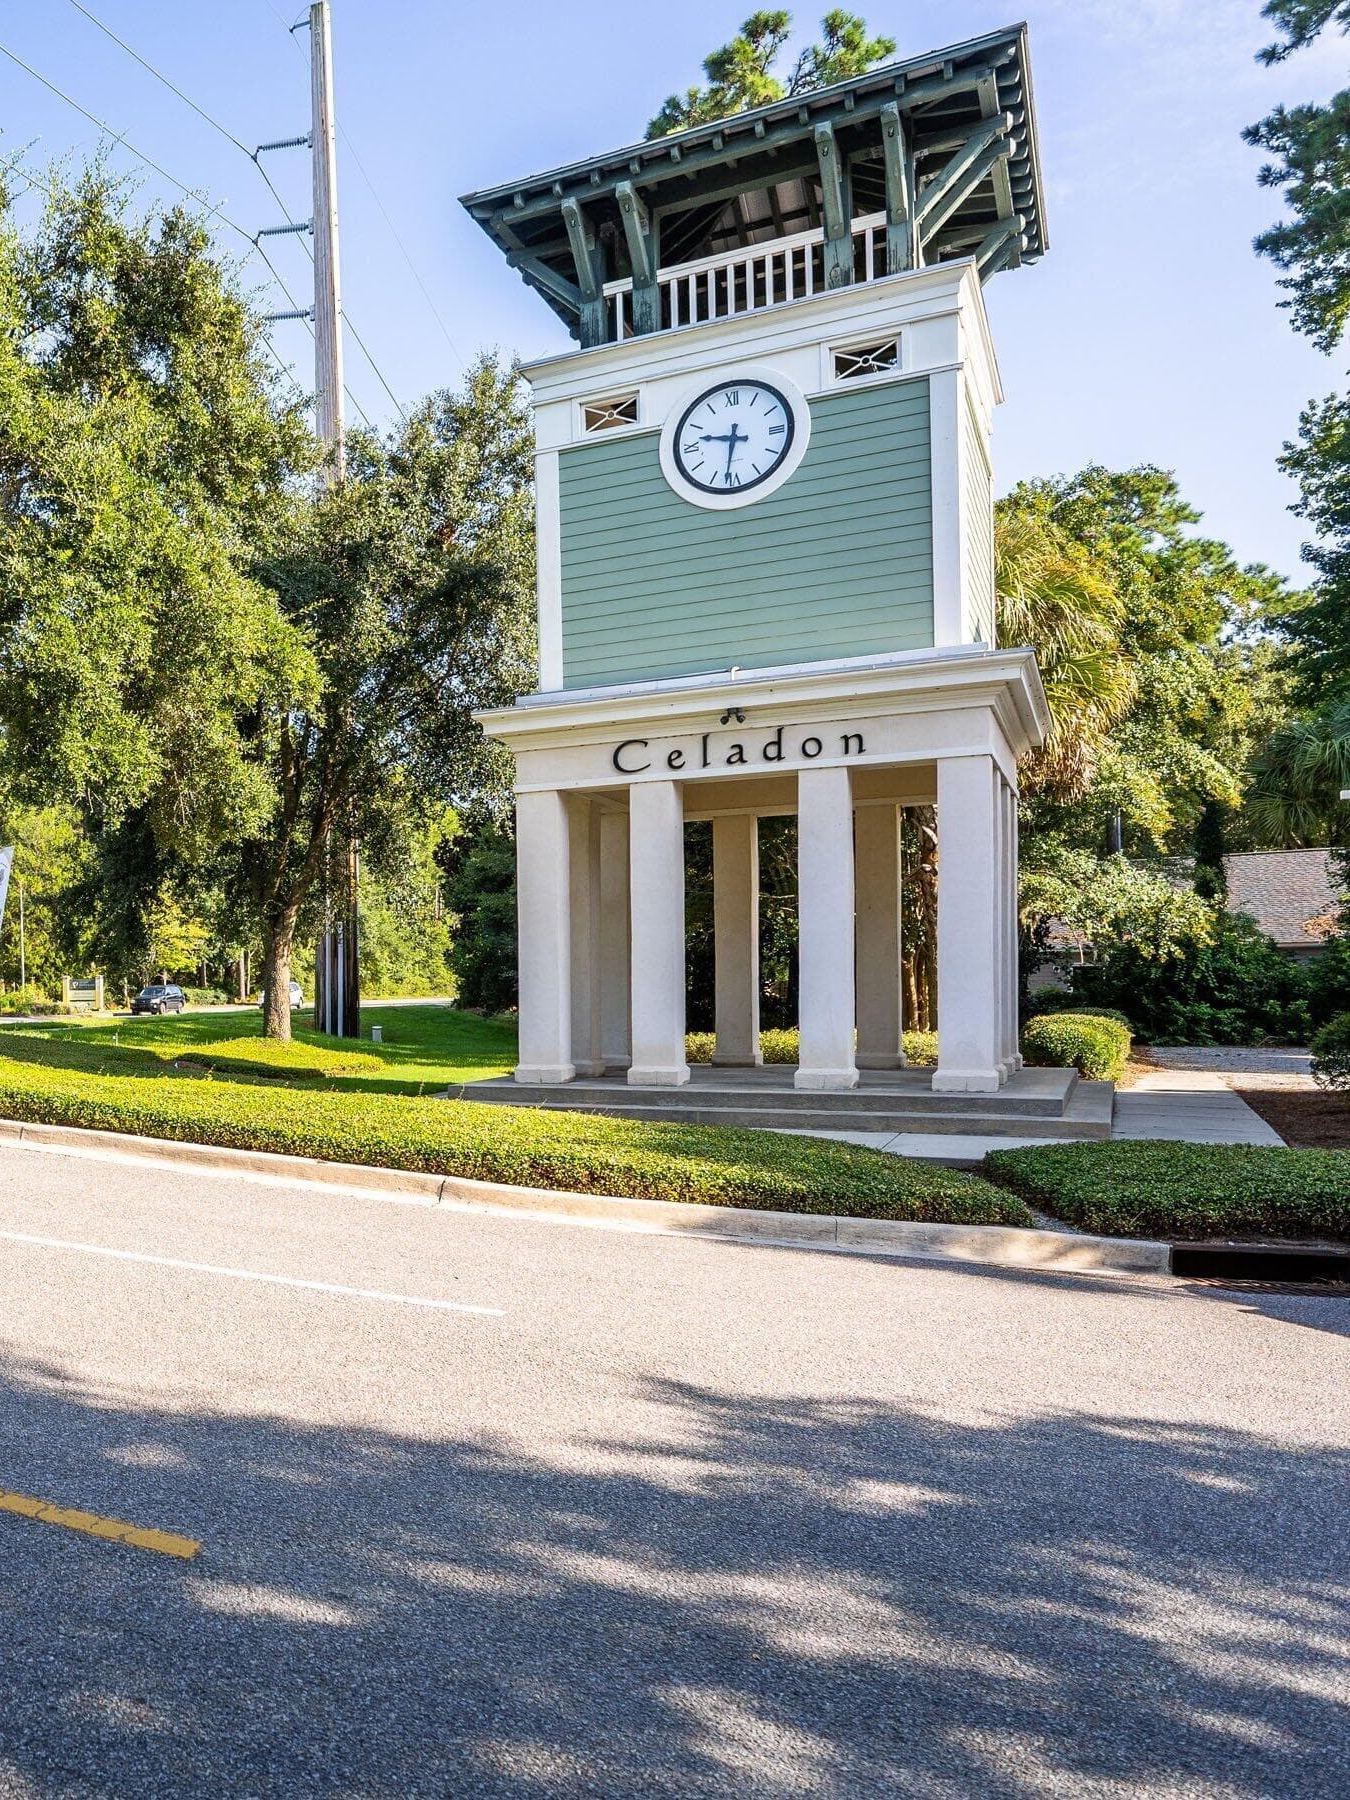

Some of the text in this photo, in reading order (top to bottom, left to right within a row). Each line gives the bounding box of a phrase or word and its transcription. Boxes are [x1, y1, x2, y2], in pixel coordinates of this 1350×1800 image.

[725, 390, 739, 408] XII
[768, 424, 785, 436] III
[612, 726, 867, 774] Celadon
